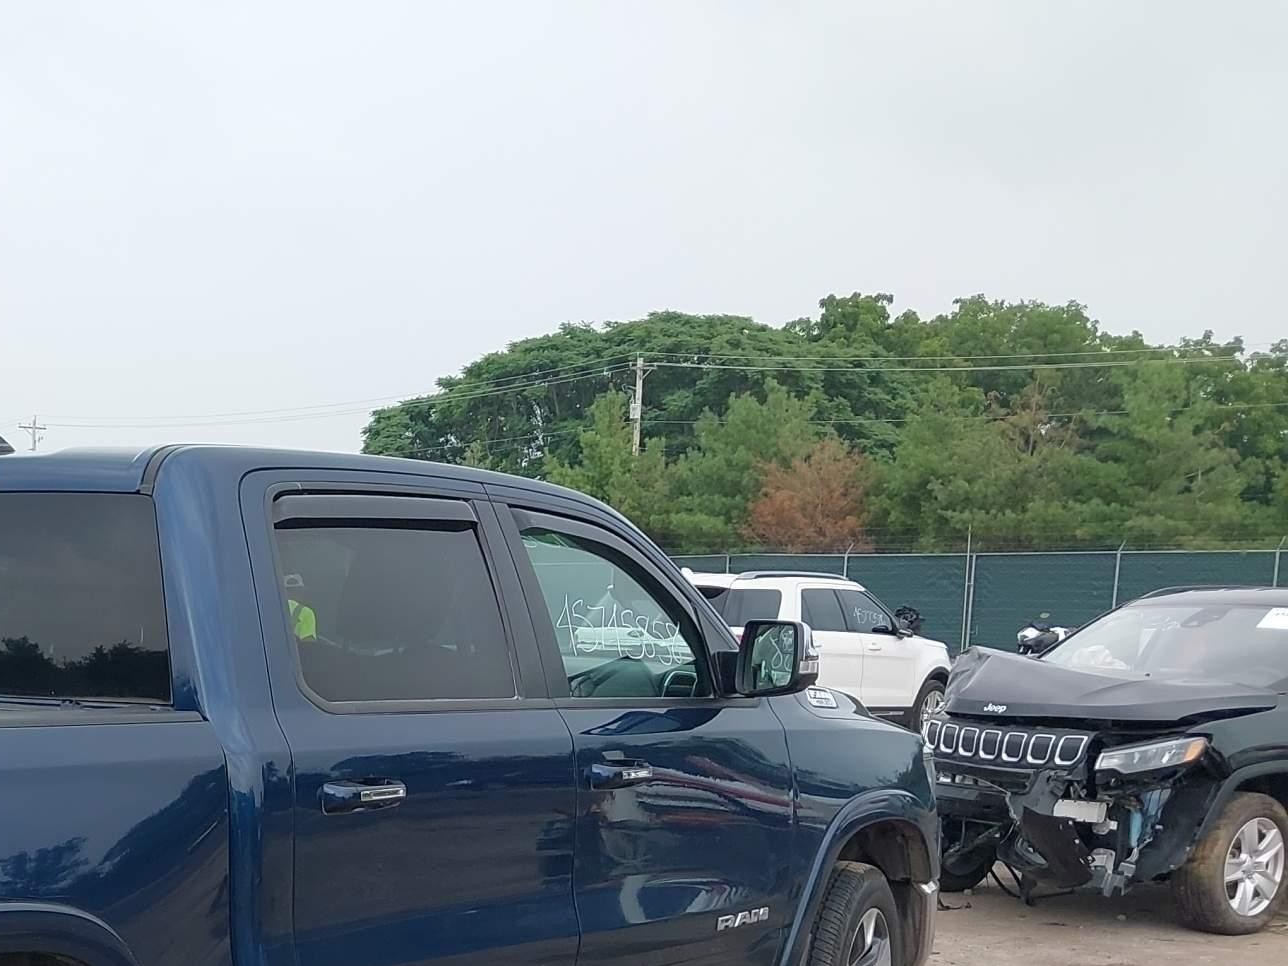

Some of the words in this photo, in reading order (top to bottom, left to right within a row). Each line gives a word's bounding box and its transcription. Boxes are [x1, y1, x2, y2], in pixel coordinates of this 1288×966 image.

[556, 593, 682, 665] 45745858
[983, 703, 1007, 713] Jeep
[717, 907, 769, 931] RAM
